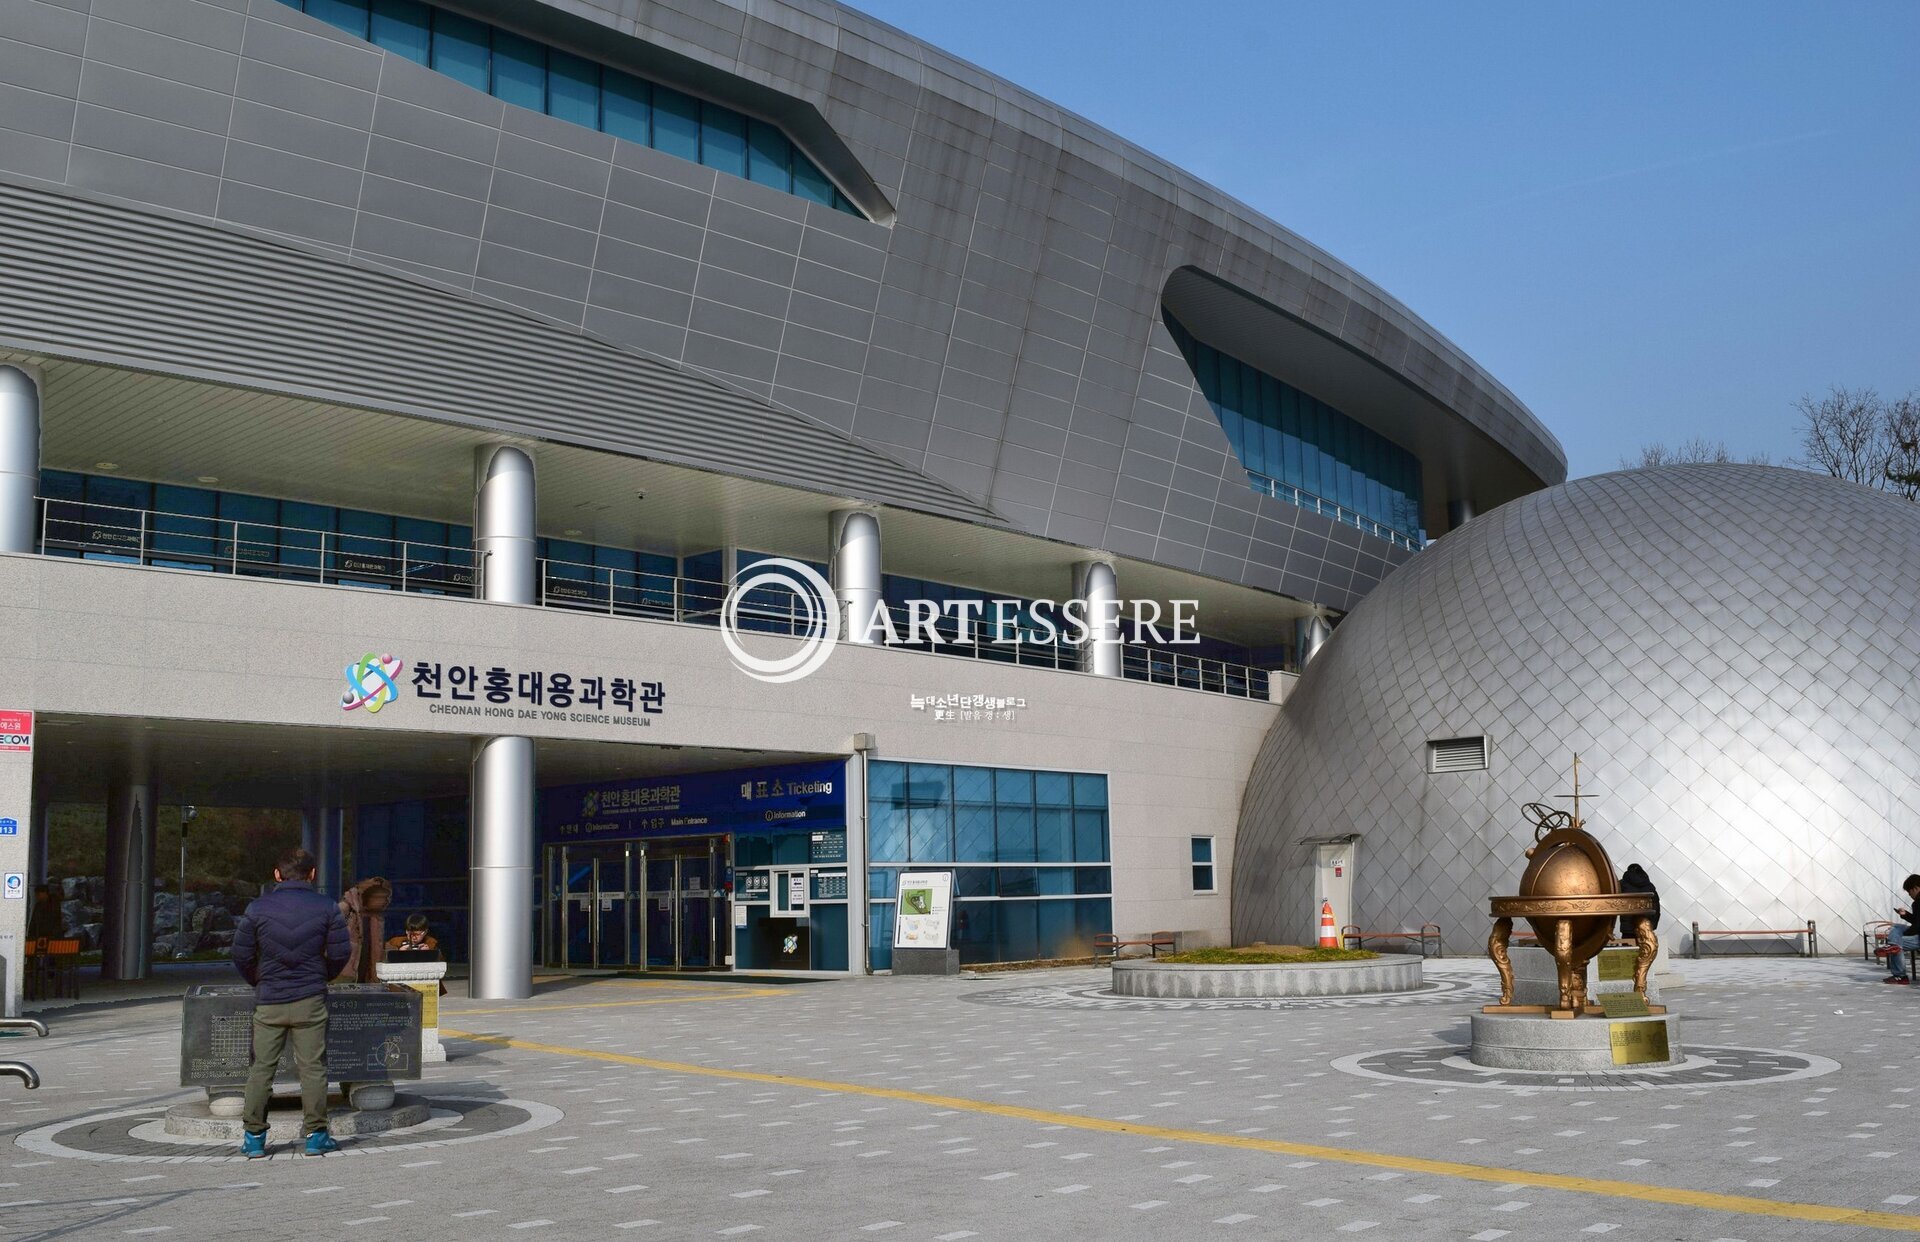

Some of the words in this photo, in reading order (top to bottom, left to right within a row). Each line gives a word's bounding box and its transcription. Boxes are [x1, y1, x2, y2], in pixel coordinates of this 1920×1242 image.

[412, 662, 666, 714] 천안홍대용과학관
[429, 704, 481, 717] CHEONAN
[484, 707, 514, 719] HONG
[518, 709, 538, 720] DAE
[540, 711, 566, 722] YONG
[570, 714, 610, 725] SCIENCE
[613, 715, 651, 727] MUSEUM
[787, 780, 833, 795] Ticketing
[671, 818, 684, 826] Main
[773, 810, 806, 820] Information
